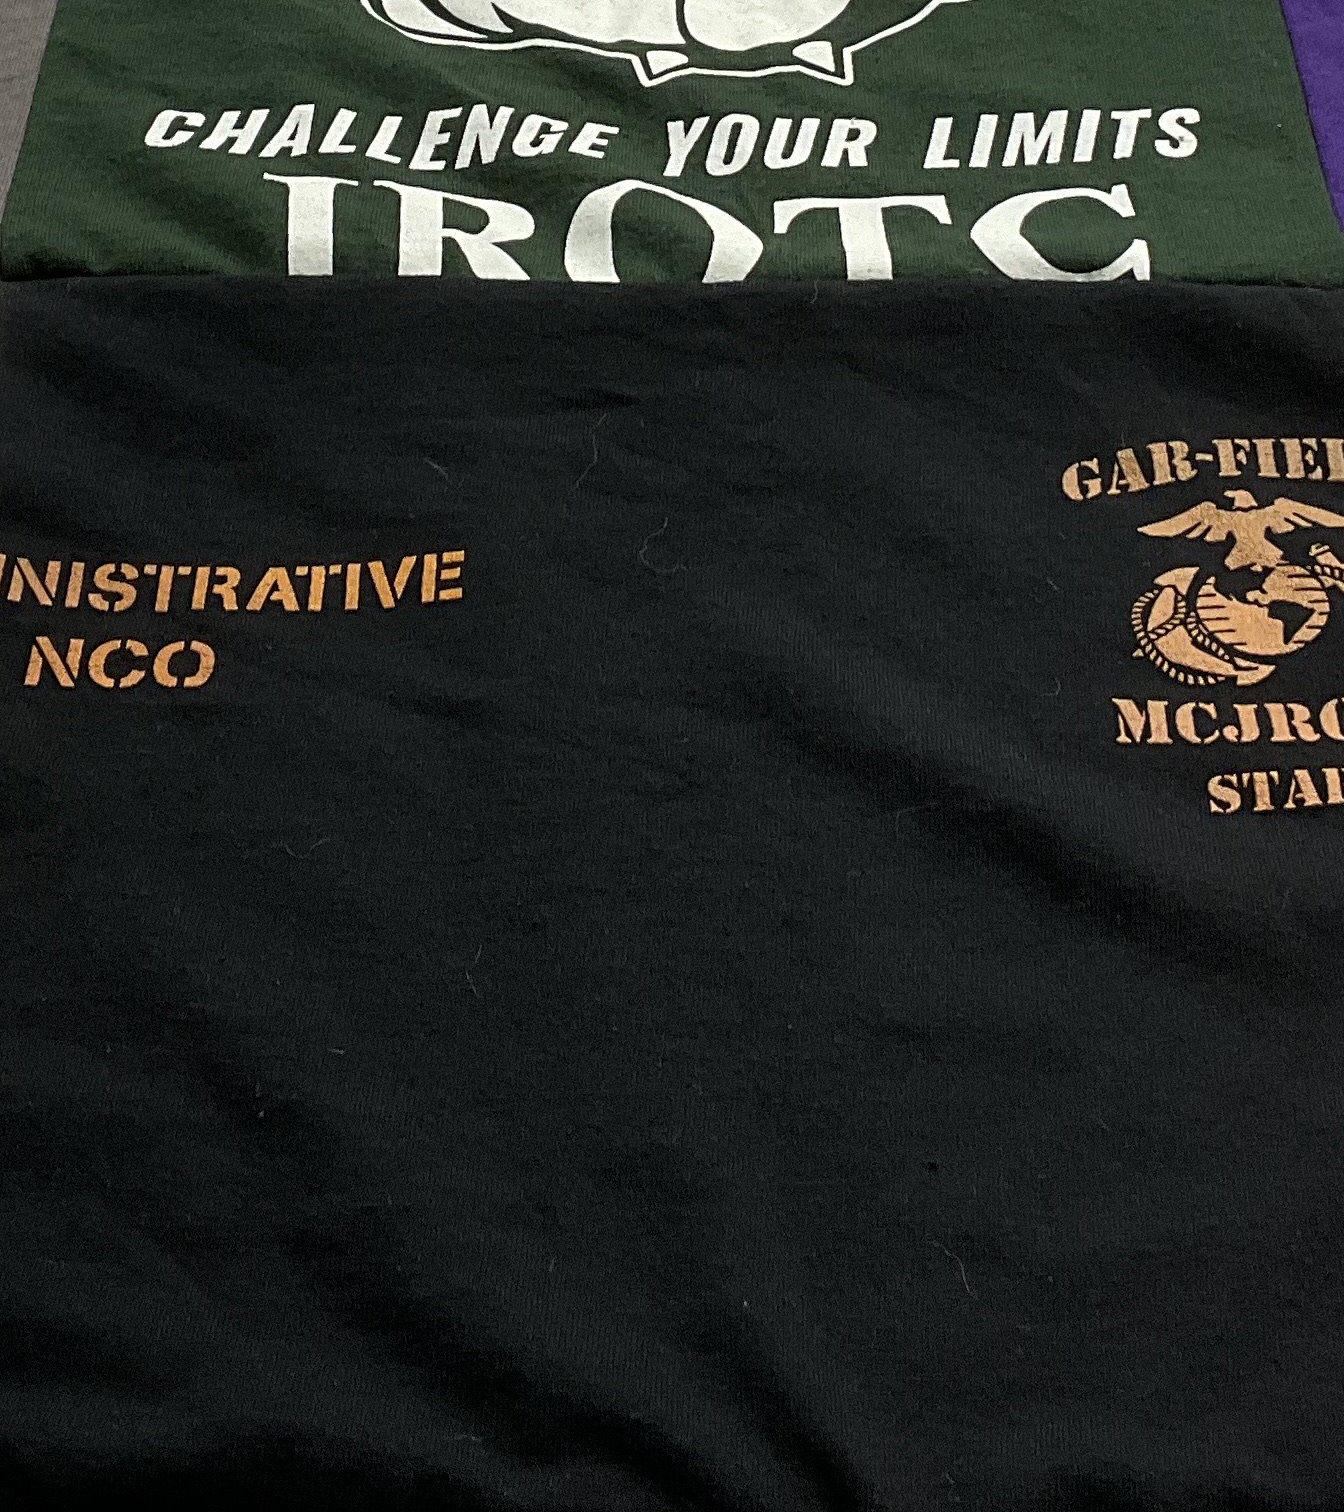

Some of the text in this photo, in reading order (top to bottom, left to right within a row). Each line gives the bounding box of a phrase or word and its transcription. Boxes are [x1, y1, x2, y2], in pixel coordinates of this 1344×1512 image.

[142, 101, 1202, 178] CHALLENGE YOUR LIMITS
[23, 635, 218, 689] NCO
